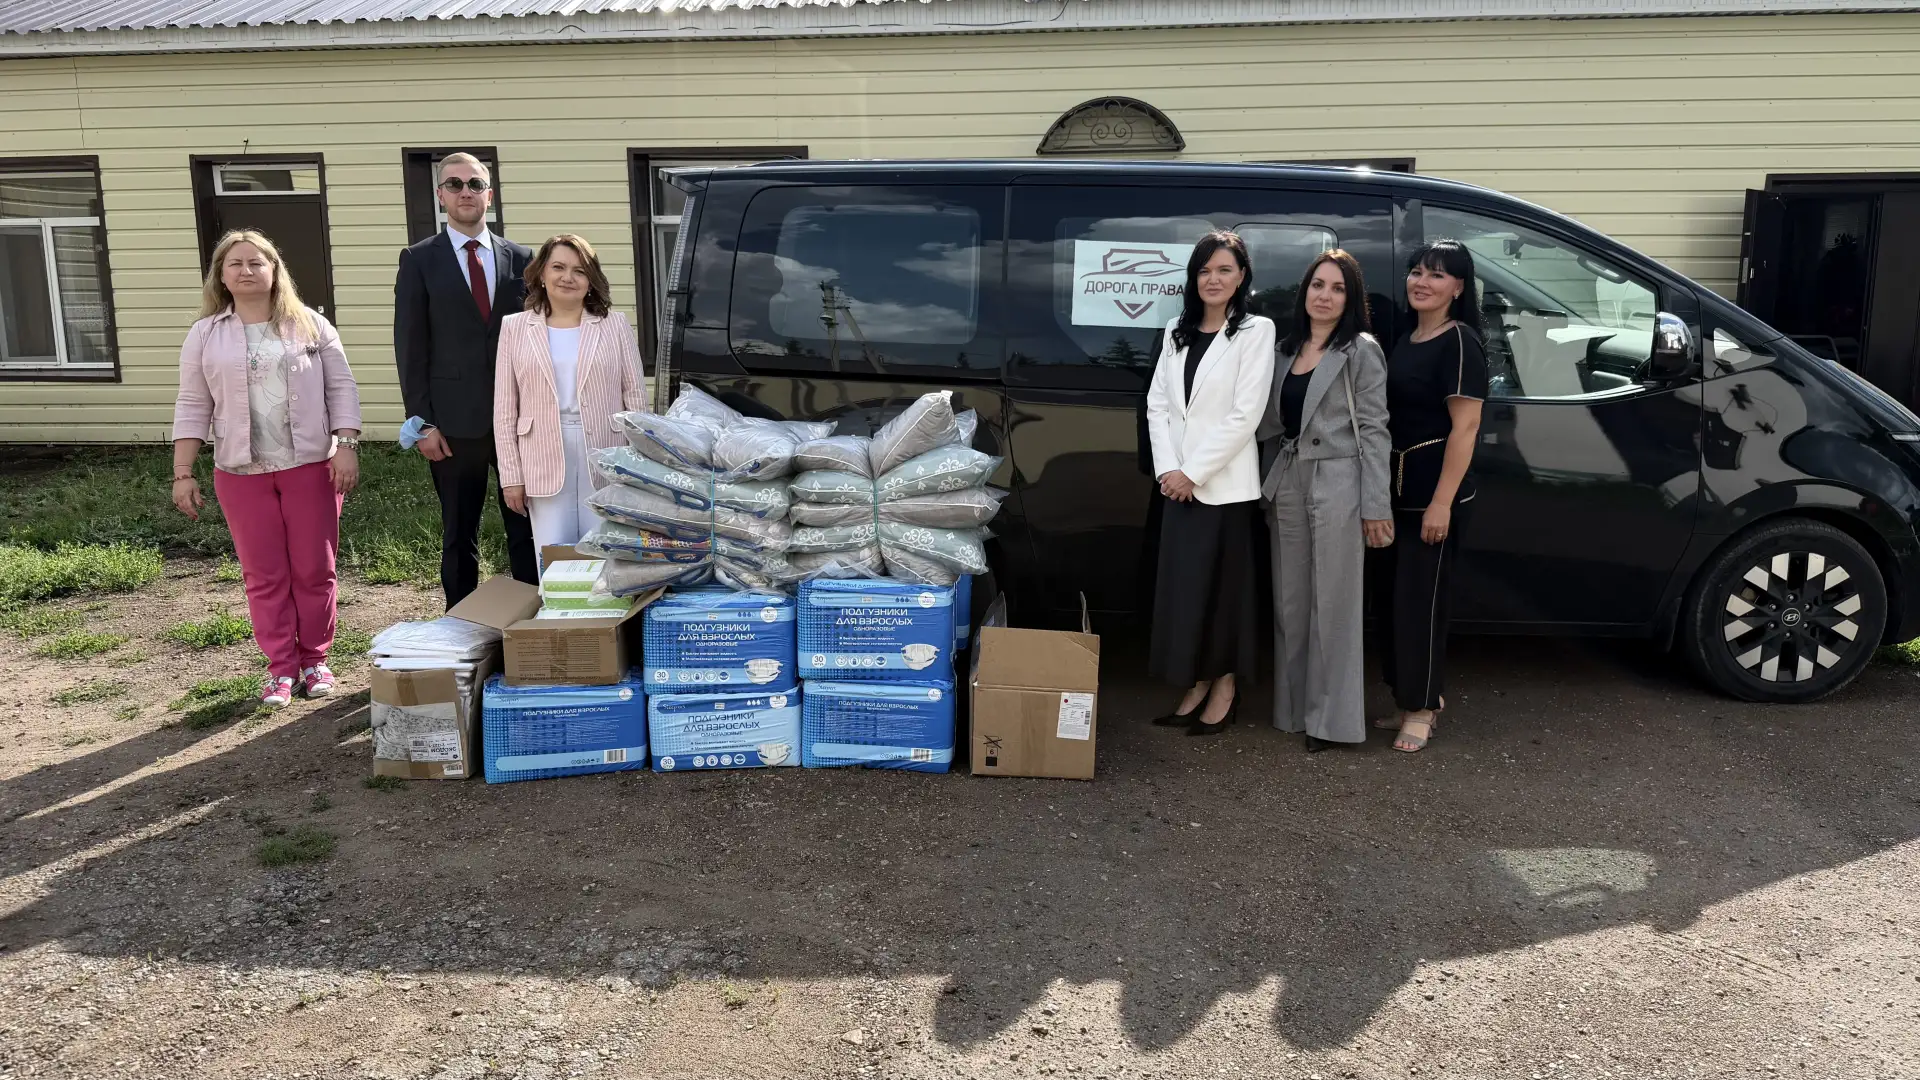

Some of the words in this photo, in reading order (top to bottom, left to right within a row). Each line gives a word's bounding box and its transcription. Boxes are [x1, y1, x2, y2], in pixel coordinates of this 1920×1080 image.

[1084, 281, 1137, 294] ДОРОГА
[1141, 283, 1185, 296] ПРАВА
[683, 624, 750, 632] ПОДГУЗНИКИ
[522, 708, 564, 716] ПОДГУЗНИКИ
[688, 712, 754, 722] ПОДГУЗНИКИ
[683, 724, 704, 732] ДЛЯ
[706, 722, 760, 732] ВЗРОСЛЫХ
